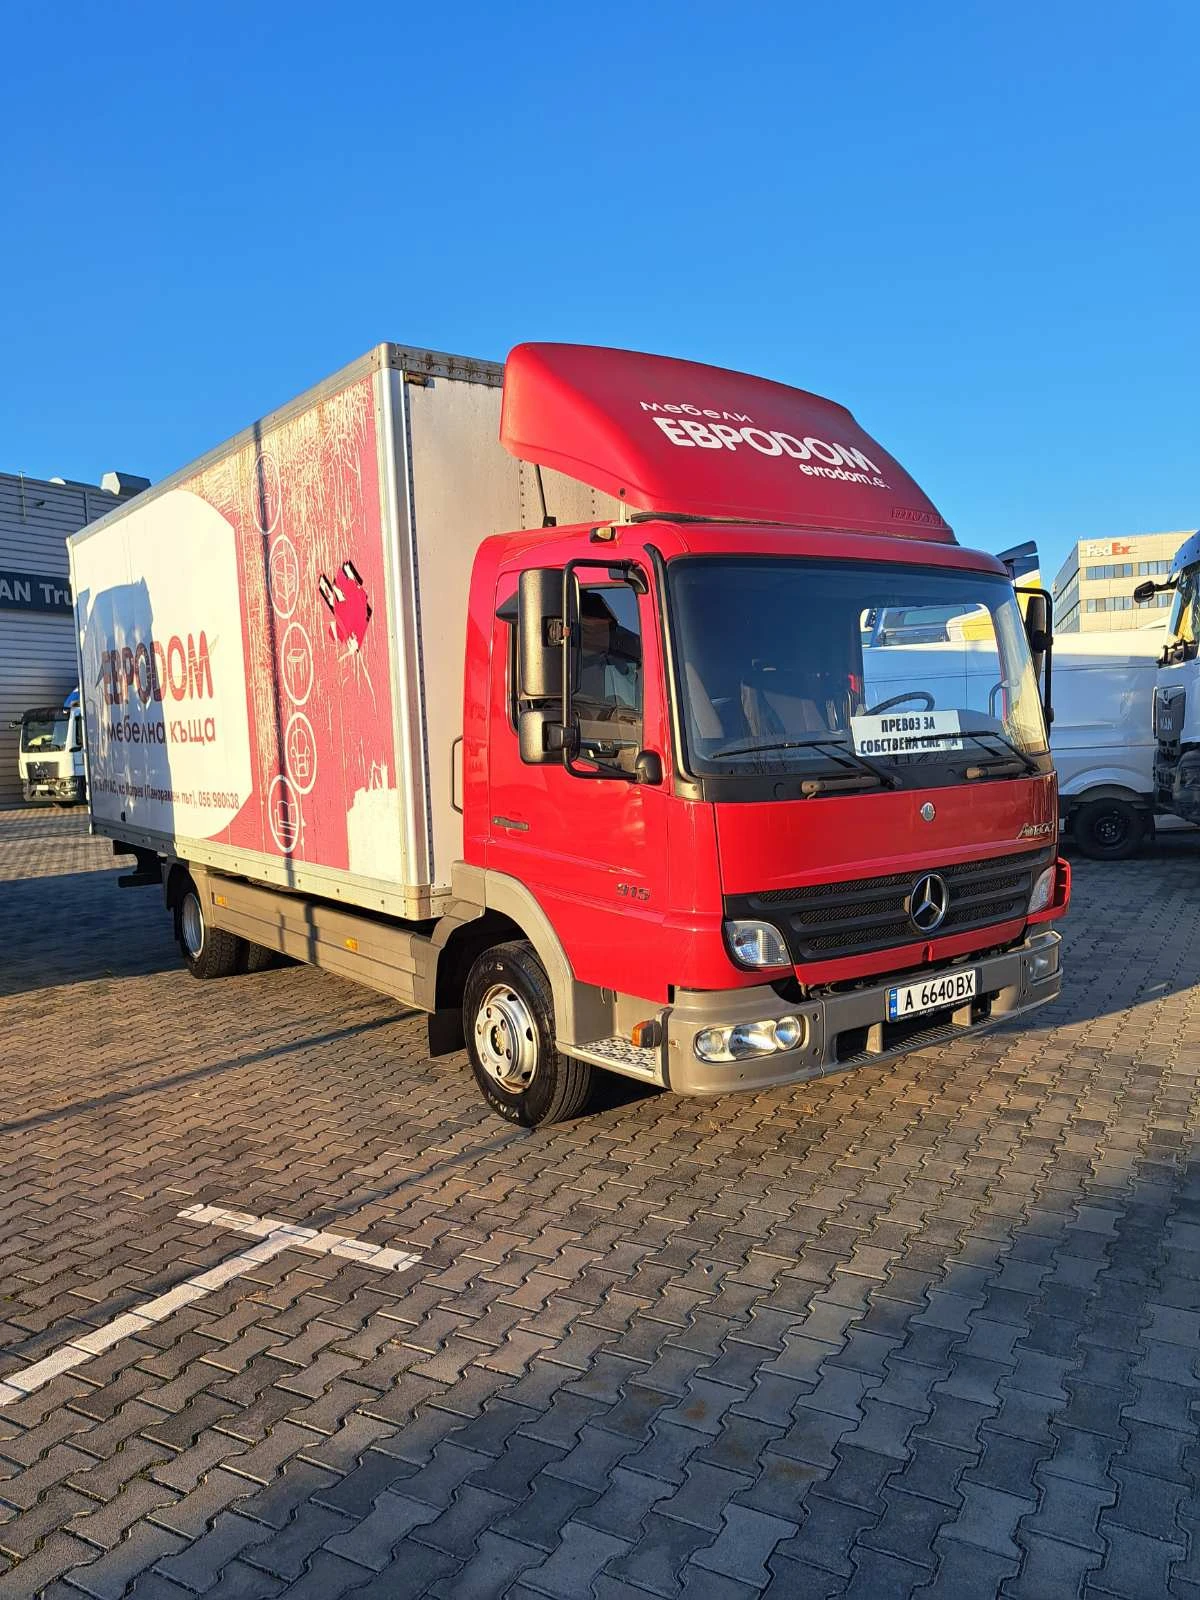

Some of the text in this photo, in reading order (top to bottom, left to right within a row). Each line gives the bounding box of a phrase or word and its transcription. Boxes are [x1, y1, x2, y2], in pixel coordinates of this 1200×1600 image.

[640, 401, 754, 423] мебели
[799, 463, 893, 490] evrodom.e
[1087, 542, 1130, 557] FedEx
[108, 714, 216, 746] мебелна къща
[881, 716, 936, 732] ПРЕВОЗ ЗА
[860, 736, 919, 754] СОБСТВЕНА
[616, 883, 651, 902] 915
[904, 989, 914, 1011] A
[921, 979, 955, 1006] 6640
